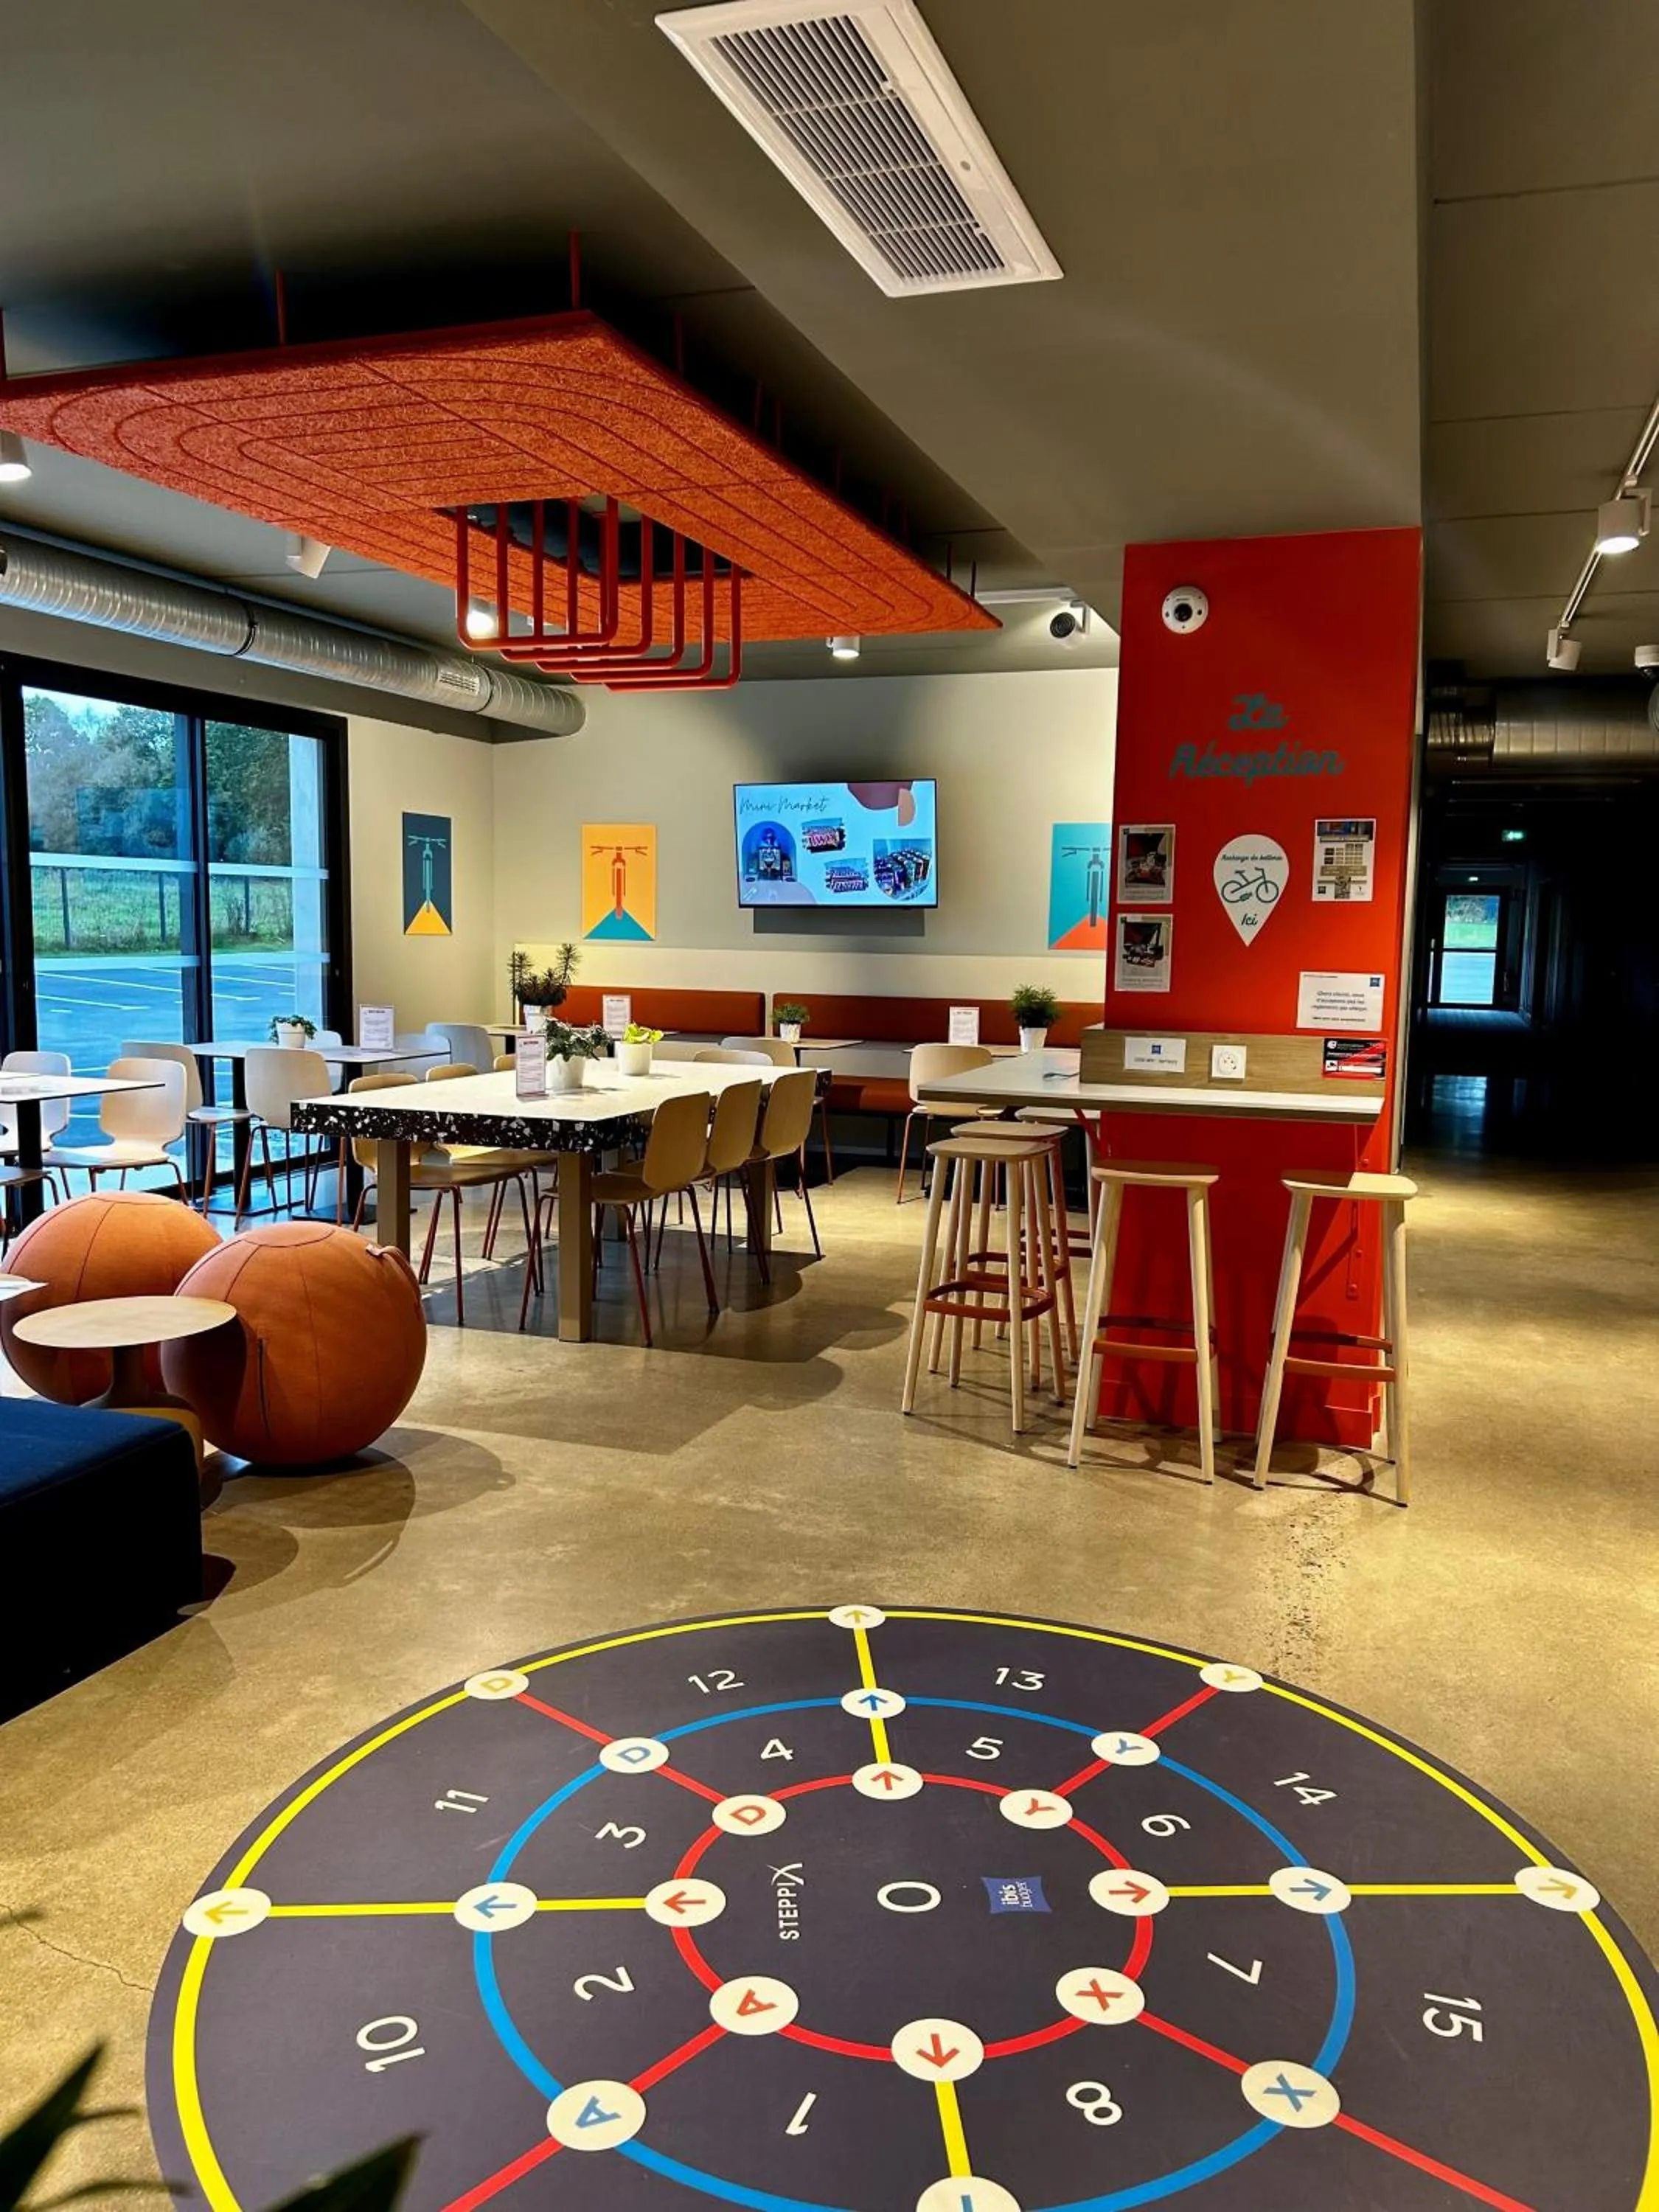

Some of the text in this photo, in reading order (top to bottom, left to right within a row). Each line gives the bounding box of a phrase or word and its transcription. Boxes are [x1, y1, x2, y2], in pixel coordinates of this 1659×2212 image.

[1169, 740, 1345, 788] Réception
[778, 796, 830, 814] Market
[1242, 913, 1258, 925] Ici
[480, 1677, 513, 1693] D
[688, 1670, 745, 1694] 12
[995, 1667, 1046, 1691] 13
[616, 1745, 651, 1765] D
[760, 1737, 794, 1761] 4
[965, 1736, 1004, 1761] 5
[1115, 1738, 1144, 1755] Y
[434, 1789, 490, 1814] 11
[1273, 1771, 1338, 1806] 14
[728, 1804, 767, 1826] D
[1023, 1797, 1057, 1817] Y
[594, 1821, 647, 1849] 3
[1141, 1814, 1191, 1837] 6
[766, 1862, 805, 1941] STEPPIX
[998, 1883, 1020, 1905] ibis
[1016, 1880, 1034, 1908] budget
[1207, 1952, 1263, 1986] 7
[574, 1966, 635, 2002] 2
[1074, 1978, 1125, 2011] X
[735, 1989, 779, 2017] A
[1422, 1992, 1484, 2042] 15
[355, 2015, 425, 2073] 10
[1065, 2081, 1123, 2126] 8
[1263, 2073, 1317, 2112] X
[574, 2096, 622, 2129] A
[785, 2092, 817, 2136] 1
